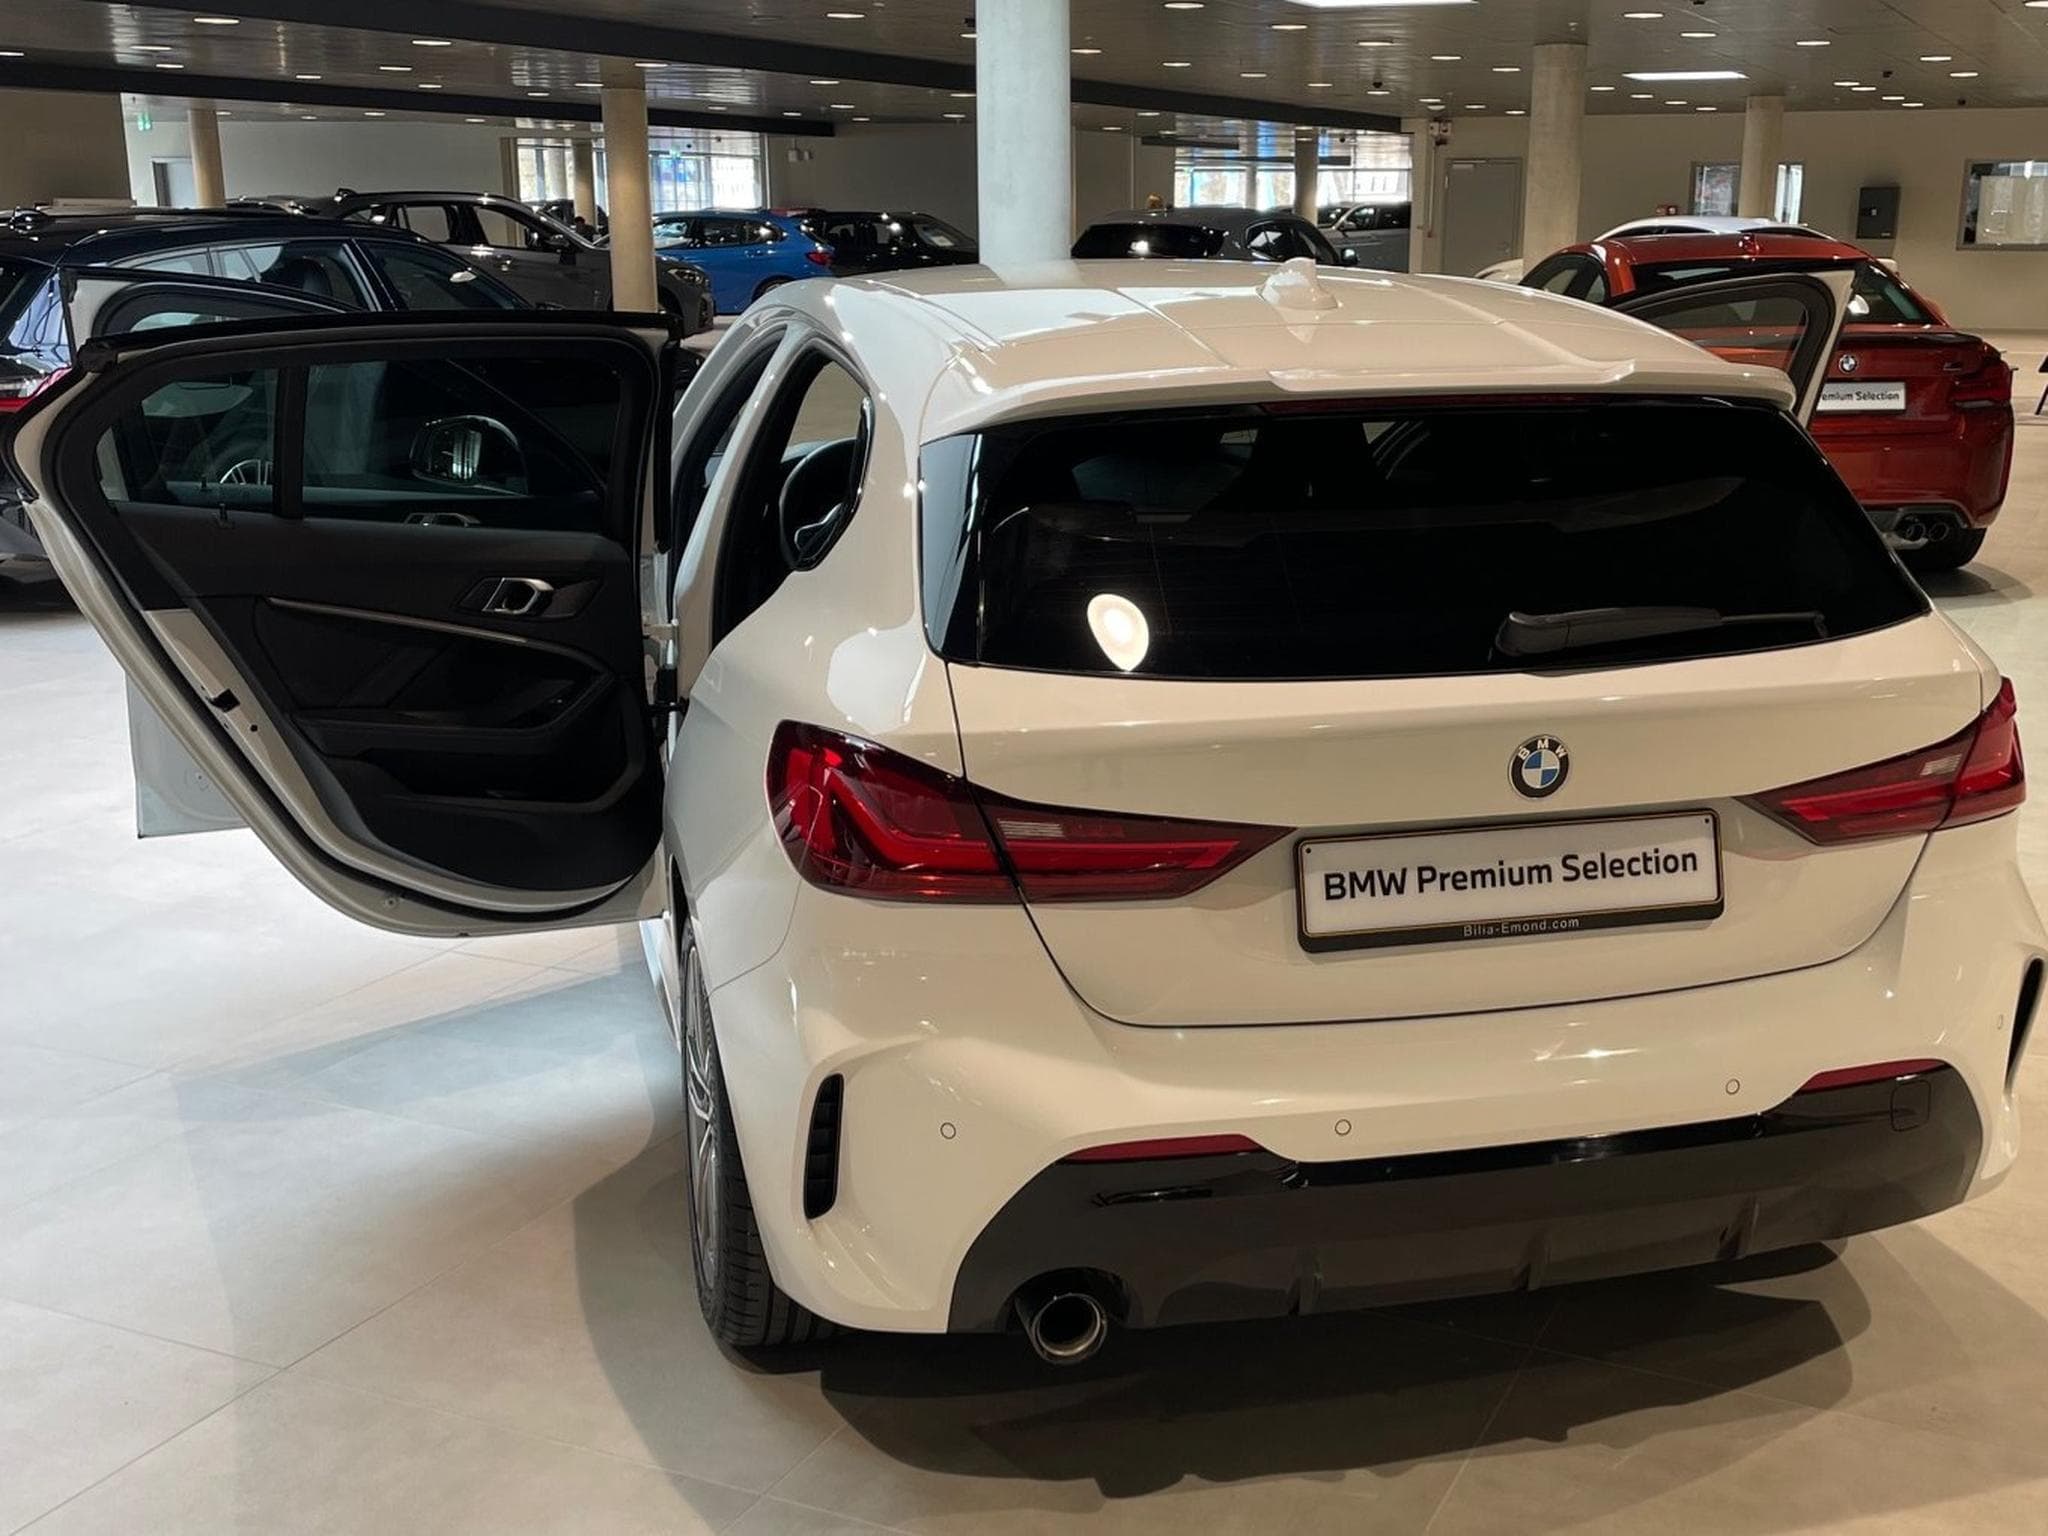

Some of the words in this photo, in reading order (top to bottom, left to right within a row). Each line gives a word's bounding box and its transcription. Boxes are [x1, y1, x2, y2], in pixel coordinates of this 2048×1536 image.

[1822, 391, 1854, 401] emium
[1855, 390, 1900, 401] Selection
[1517, 738, 1569, 760] BMW
[1324, 867, 1408, 901] BMW
[1417, 860, 1553, 894] Premium
[1561, 848, 1698, 882] Selection
[1463, 918, 1580, 937] Bilia-Emond.com
